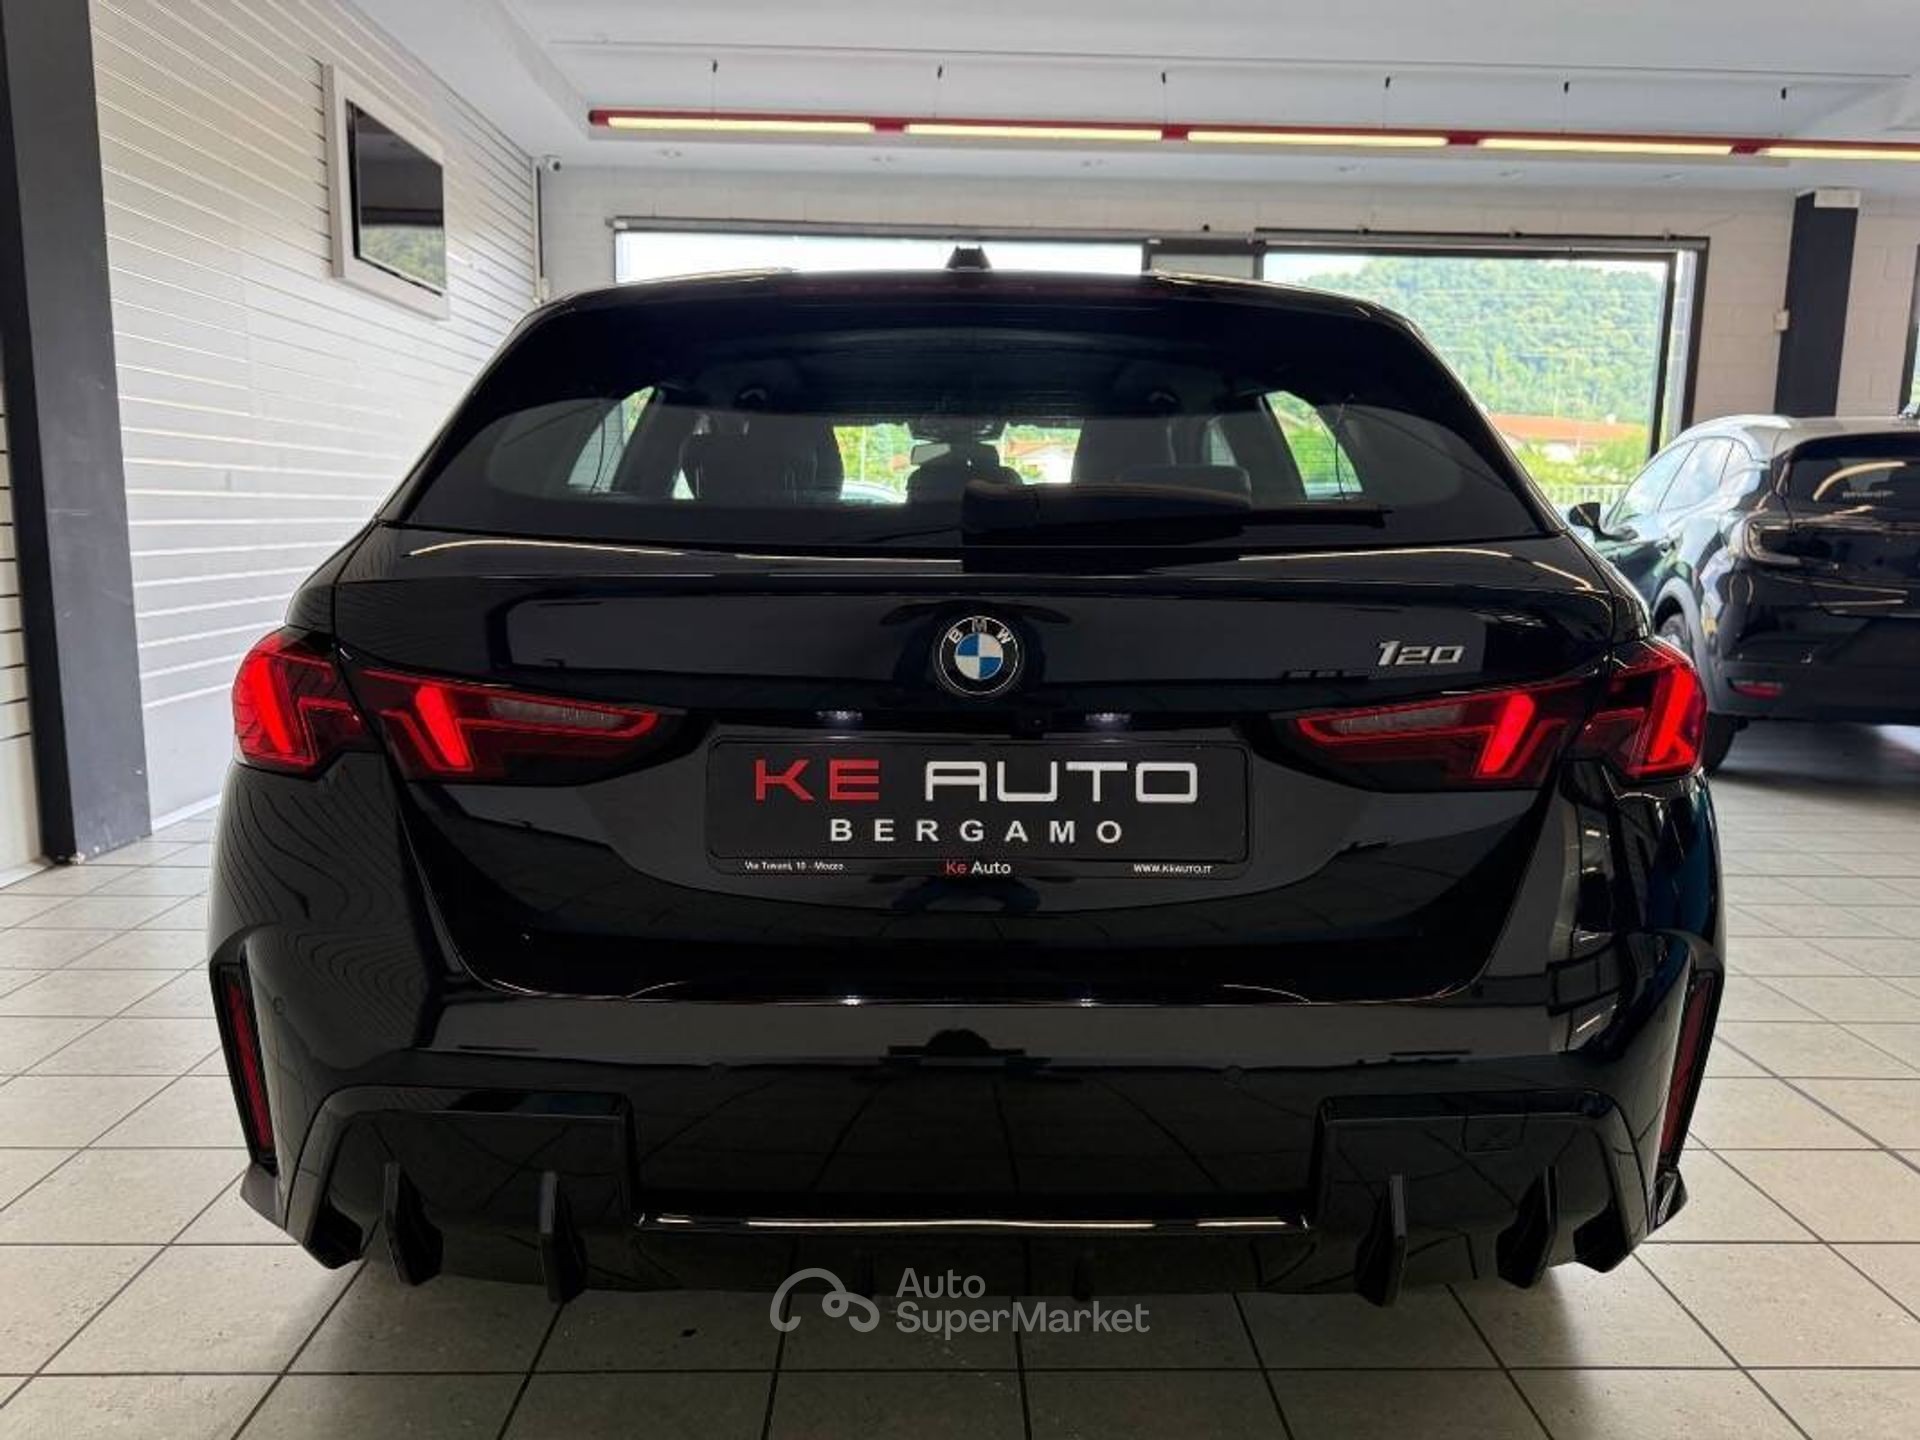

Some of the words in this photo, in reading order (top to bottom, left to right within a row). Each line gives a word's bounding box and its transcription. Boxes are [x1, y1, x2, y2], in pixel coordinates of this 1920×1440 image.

[948, 617, 1012, 644] BMW
[1377, 640, 1465, 666] 120
[755, 759, 881, 802] KE
[925, 760, 1199, 803] AUTO
[829, 819, 1123, 844] BERGAMO
[946, 860, 967, 875] Ke
[971, 860, 1011, 875] Auto
